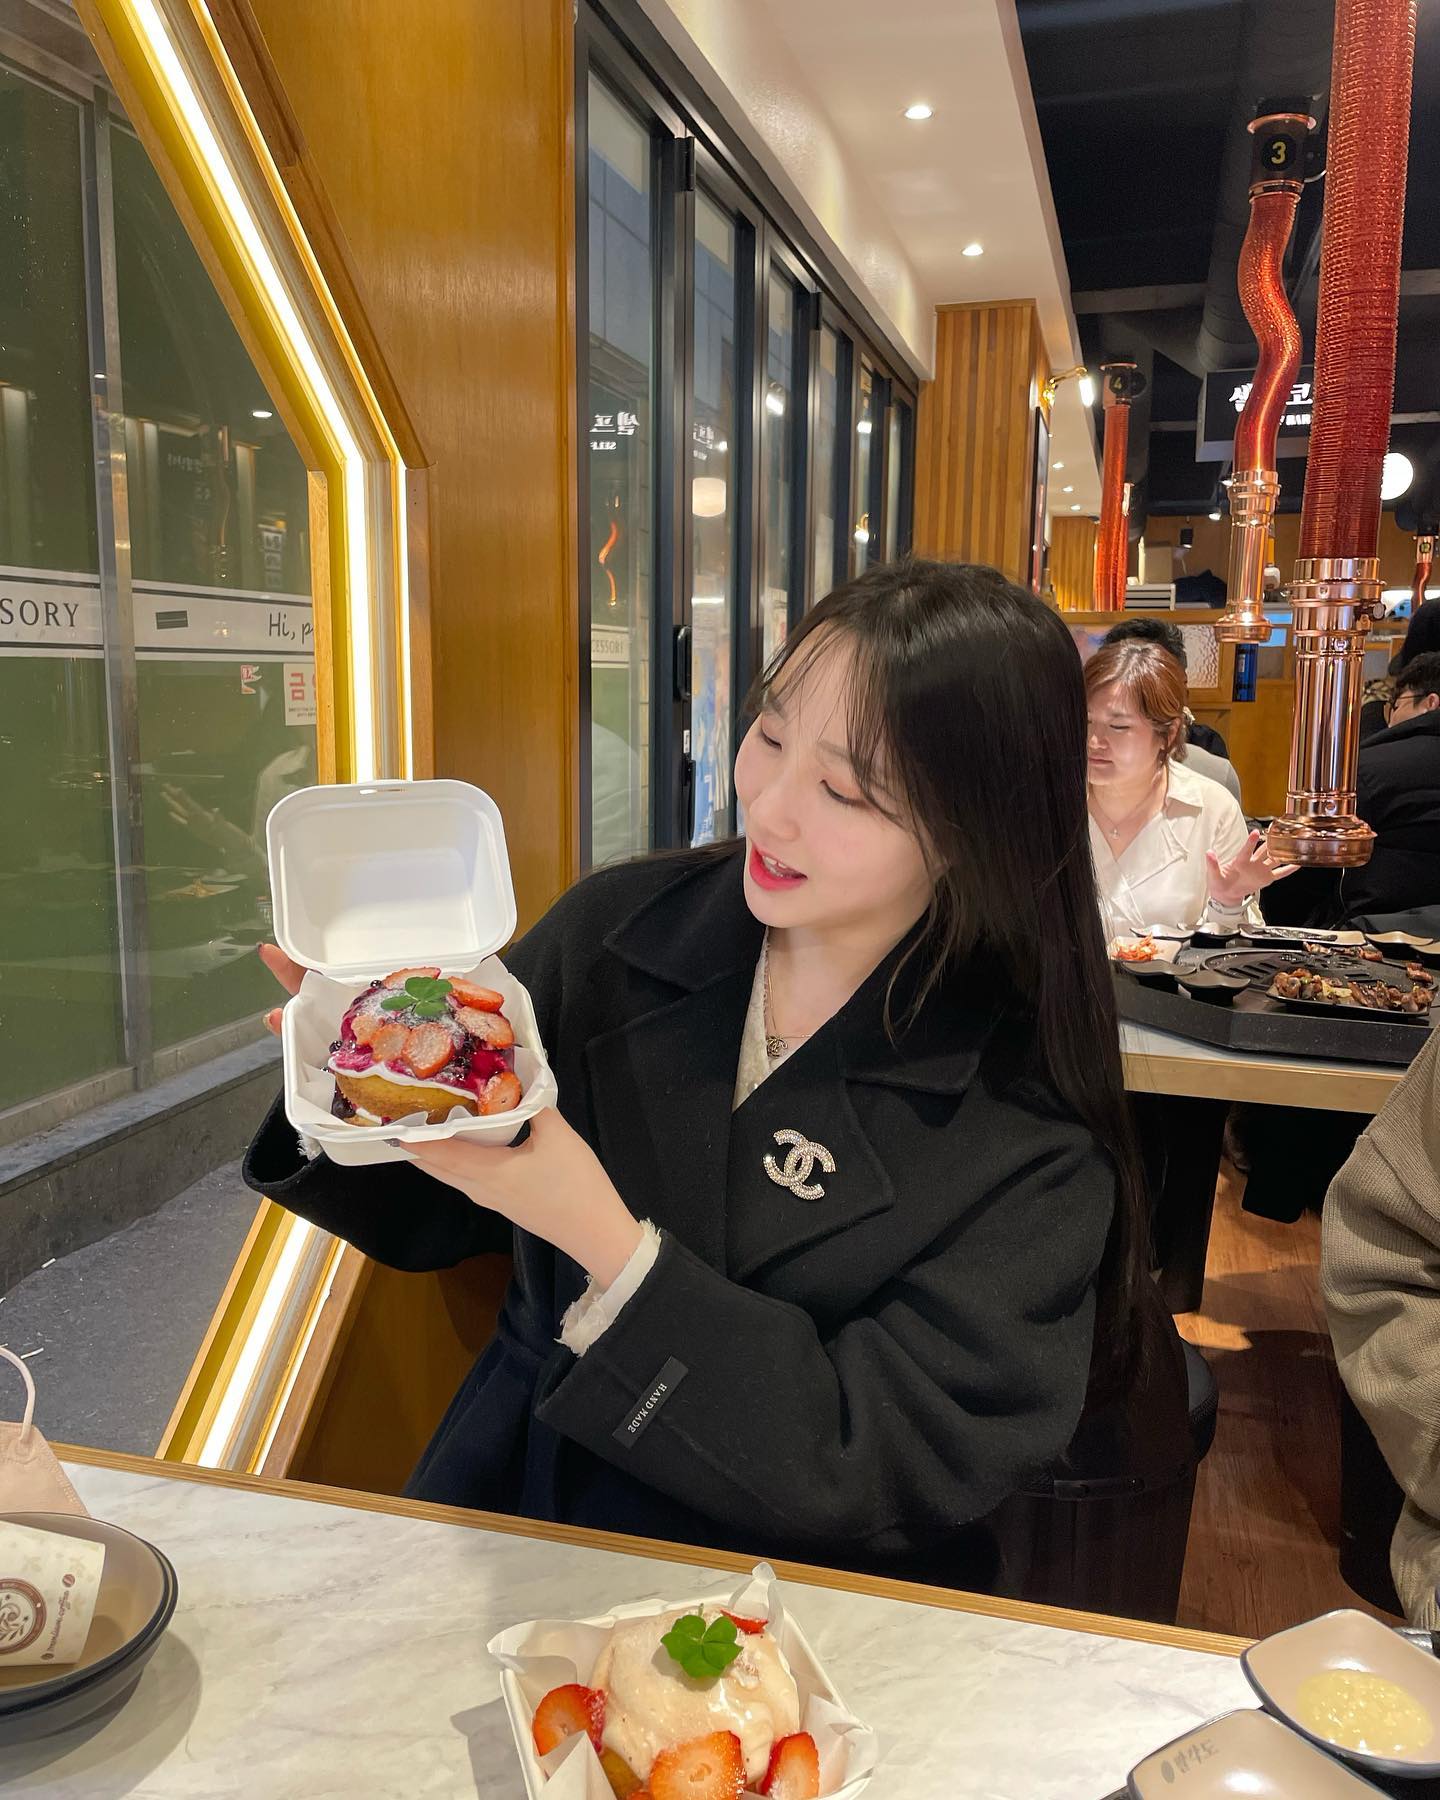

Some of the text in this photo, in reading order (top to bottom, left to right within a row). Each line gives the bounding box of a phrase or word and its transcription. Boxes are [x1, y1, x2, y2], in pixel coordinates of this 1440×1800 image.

[1271, 141, 1287, 164] 3
[1113, 376, 1122, 389] 4
[0, 598, 79, 628] SORY
[269, 611, 296, 641] Hi,
[288, 672, 316, 702] 금
[627, 1383, 667, 1433] HAND MADE
